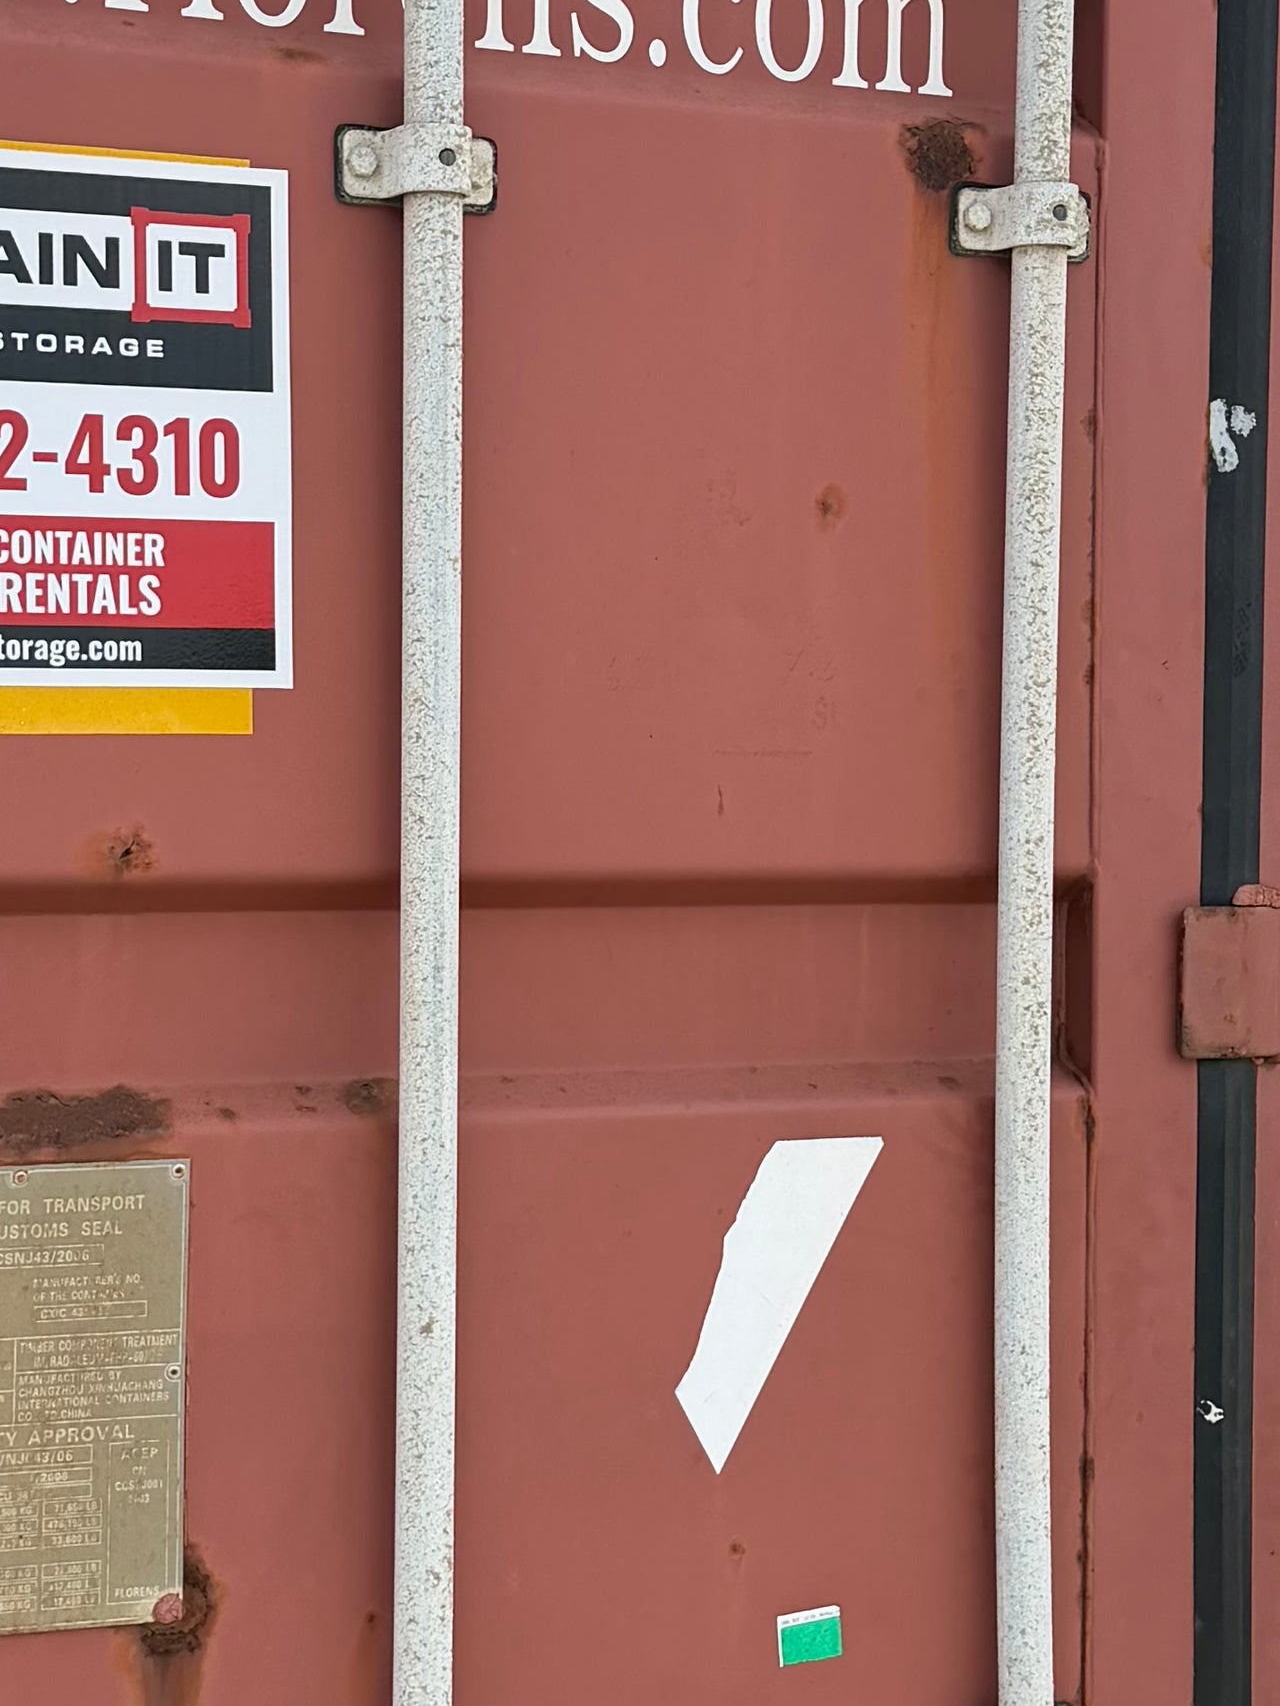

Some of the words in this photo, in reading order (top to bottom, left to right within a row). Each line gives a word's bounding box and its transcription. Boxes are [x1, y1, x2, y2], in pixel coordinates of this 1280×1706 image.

[42, 1193, 145, 1214] TRANSPORT
[80, 1219, 123, 1236] SEAL
[27, 1422, 135, 1445] APPROVAL
[114, 1583, 159, 1598] FLORENS
